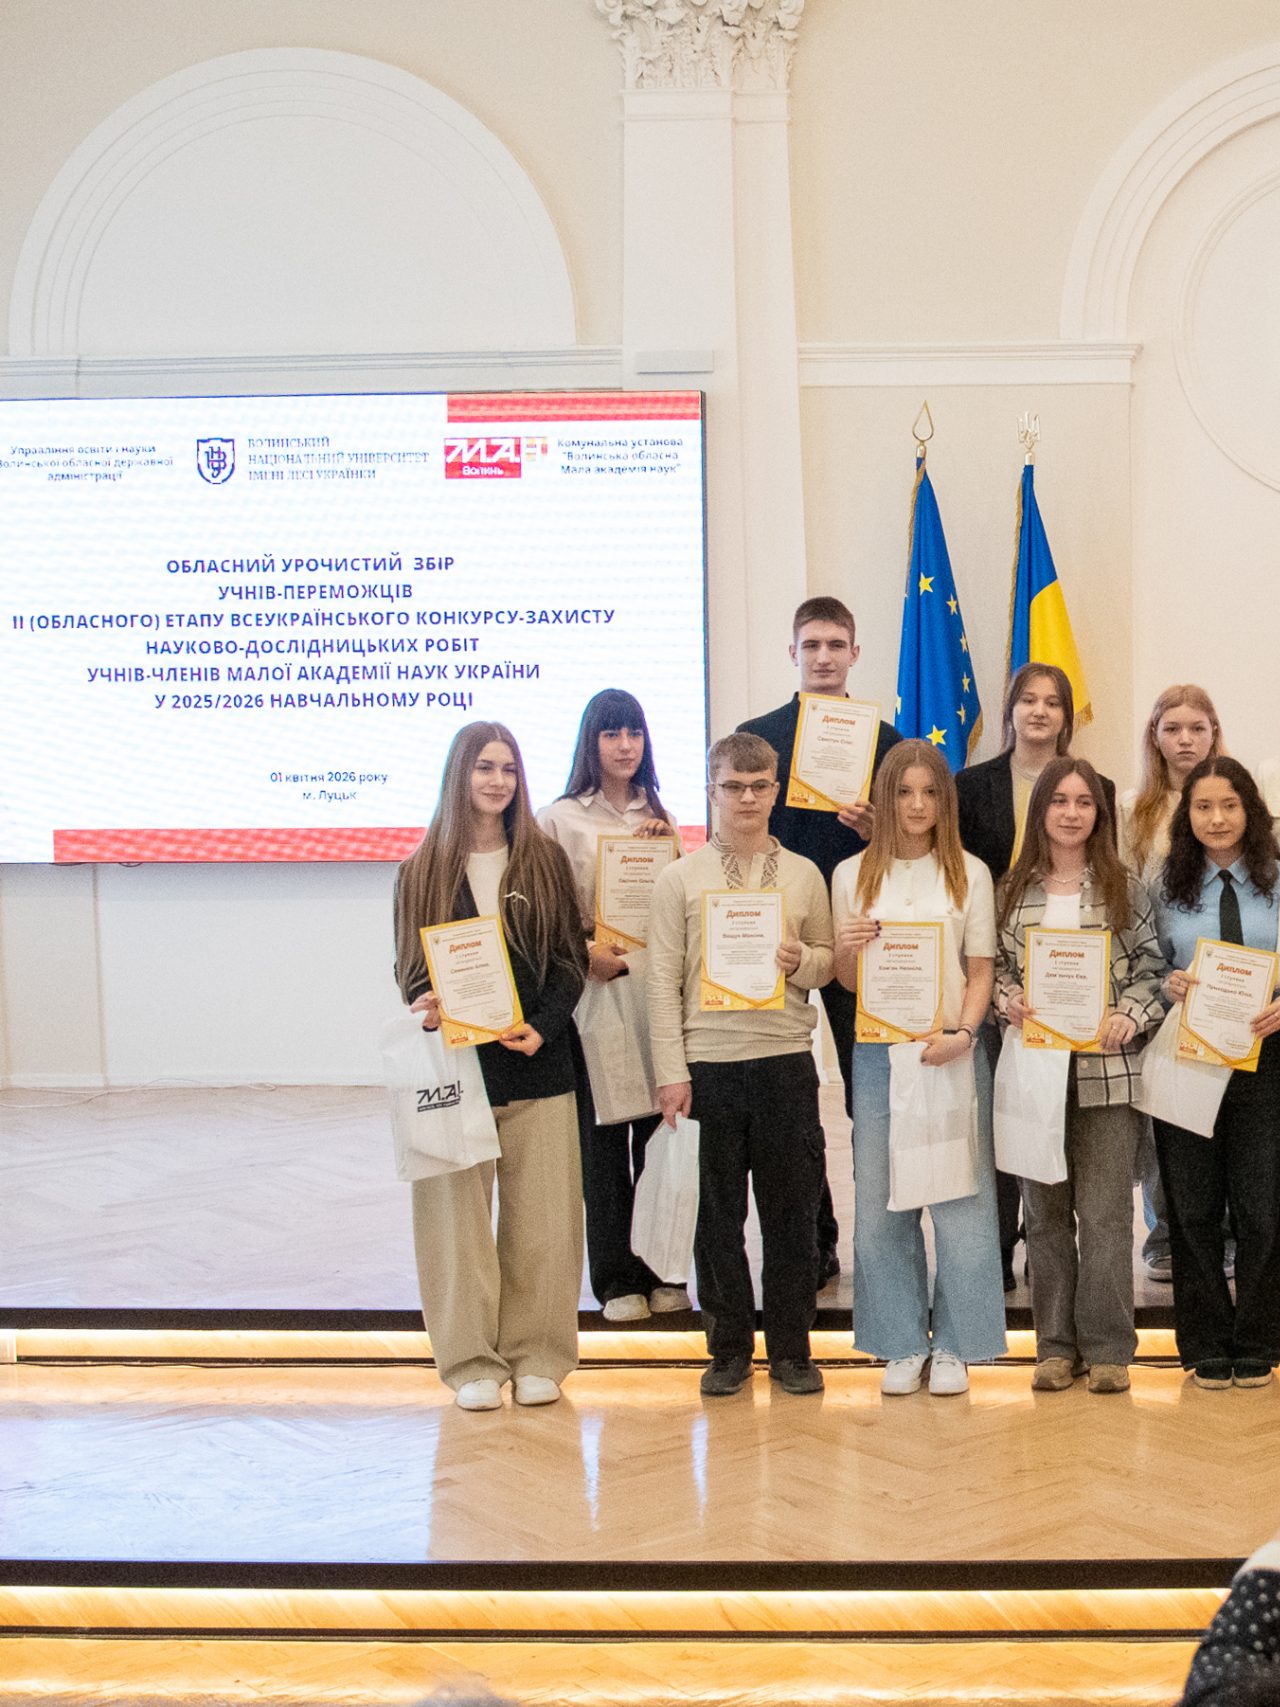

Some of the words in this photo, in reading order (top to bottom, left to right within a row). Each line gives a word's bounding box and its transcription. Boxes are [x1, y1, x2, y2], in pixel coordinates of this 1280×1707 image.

[167, 554, 275, 573] ОБЛАСНИЙ
[282, 552, 402, 572] УРОЧИСТИЙ
[414, 556, 454, 571] ЗБІР
[218, 585, 413, 603] УЧНІВ-ПЕРЕМОЖЦІВ
[30, 614, 160, 631] (ОБЛАСНОГО)
[166, 613, 224, 628] ЕТАПУ
[231, 609, 410, 627] ВСЕУКРАЇНСЬКОГО
[417, 609, 616, 626] КОНКУРСУ-ЗАХИСТУ
[147, 638, 418, 658] НАУКОВО-ДОСЛІДНИЦЬКИХ
[425, 637, 480, 653] РОБІТ
[87, 667, 221, 682] УЧНІВ-ЧЛЕНІВ
[227, 663, 292, 681] МАЛОЇ
[297, 662, 391, 684] АКАДЕМІЇ
[397, 664, 449, 680] НАУК
[454, 661, 540, 680] УКРАЇНИ
[155, 695, 166, 709] У
[172, 694, 264, 709] 2025/2026
[270, 692, 419, 708] НАВЧАЛЬНОМУ
[427, 692, 474, 711] РОЦІ
[270, 772, 283, 783] 01
[285, 774, 325, 783] квітня
[328, 771, 357, 783] 2026
[359, 773, 388, 785] року
[318, 790, 357, 803] Луцьк
[621, 856, 655, 864] Диплом
[726, 910, 762, 919] Диплом
[883, 943, 919, 951] Диплом
[1049, 949, 1085, 959] Диплом
[1216, 963, 1252, 976] Диплом
